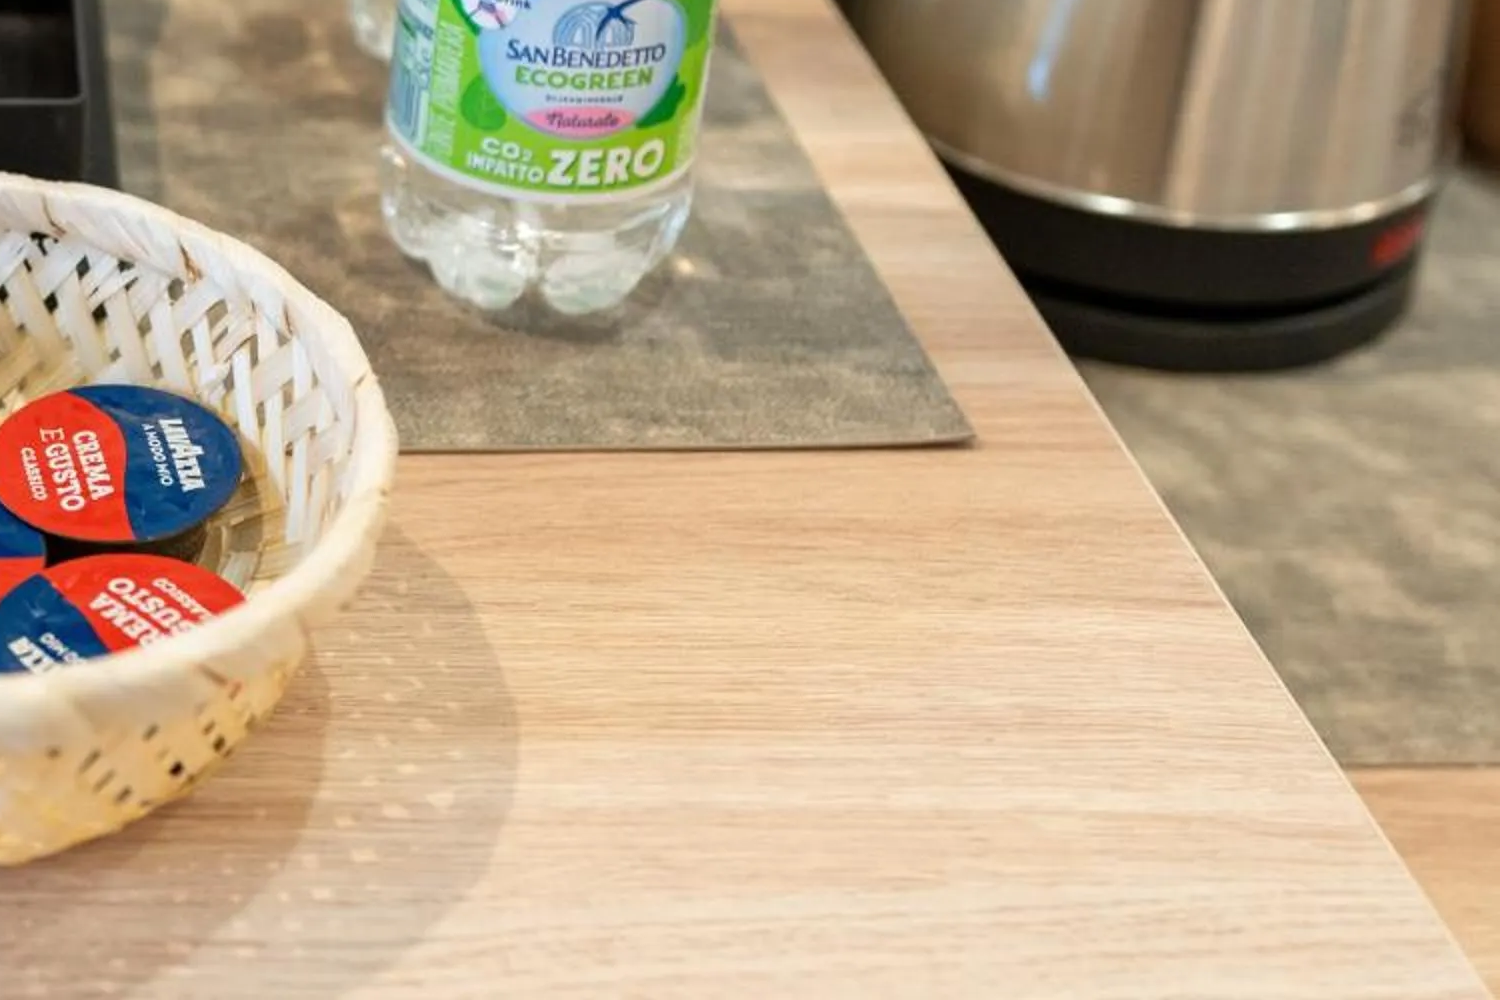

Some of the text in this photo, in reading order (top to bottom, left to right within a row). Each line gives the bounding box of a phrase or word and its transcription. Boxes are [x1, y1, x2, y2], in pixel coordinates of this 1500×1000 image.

[514, 66, 654, 91] ECOGREEN
[544, 111, 622, 130] Naturale
[467, 138, 665, 187] IMPATTO ZERO
[39, 427, 86, 513] E GUSTO
[71, 429, 115, 501] CREMA
[146, 431, 167, 464] MODO
[158, 417, 207, 493] LAVAZZA
[20, 446, 48, 502] CLASSICO
[155, 463, 174, 488] MIO
[89, 591, 162, 647] REMA
[152, 576, 218, 624] LASSICO
